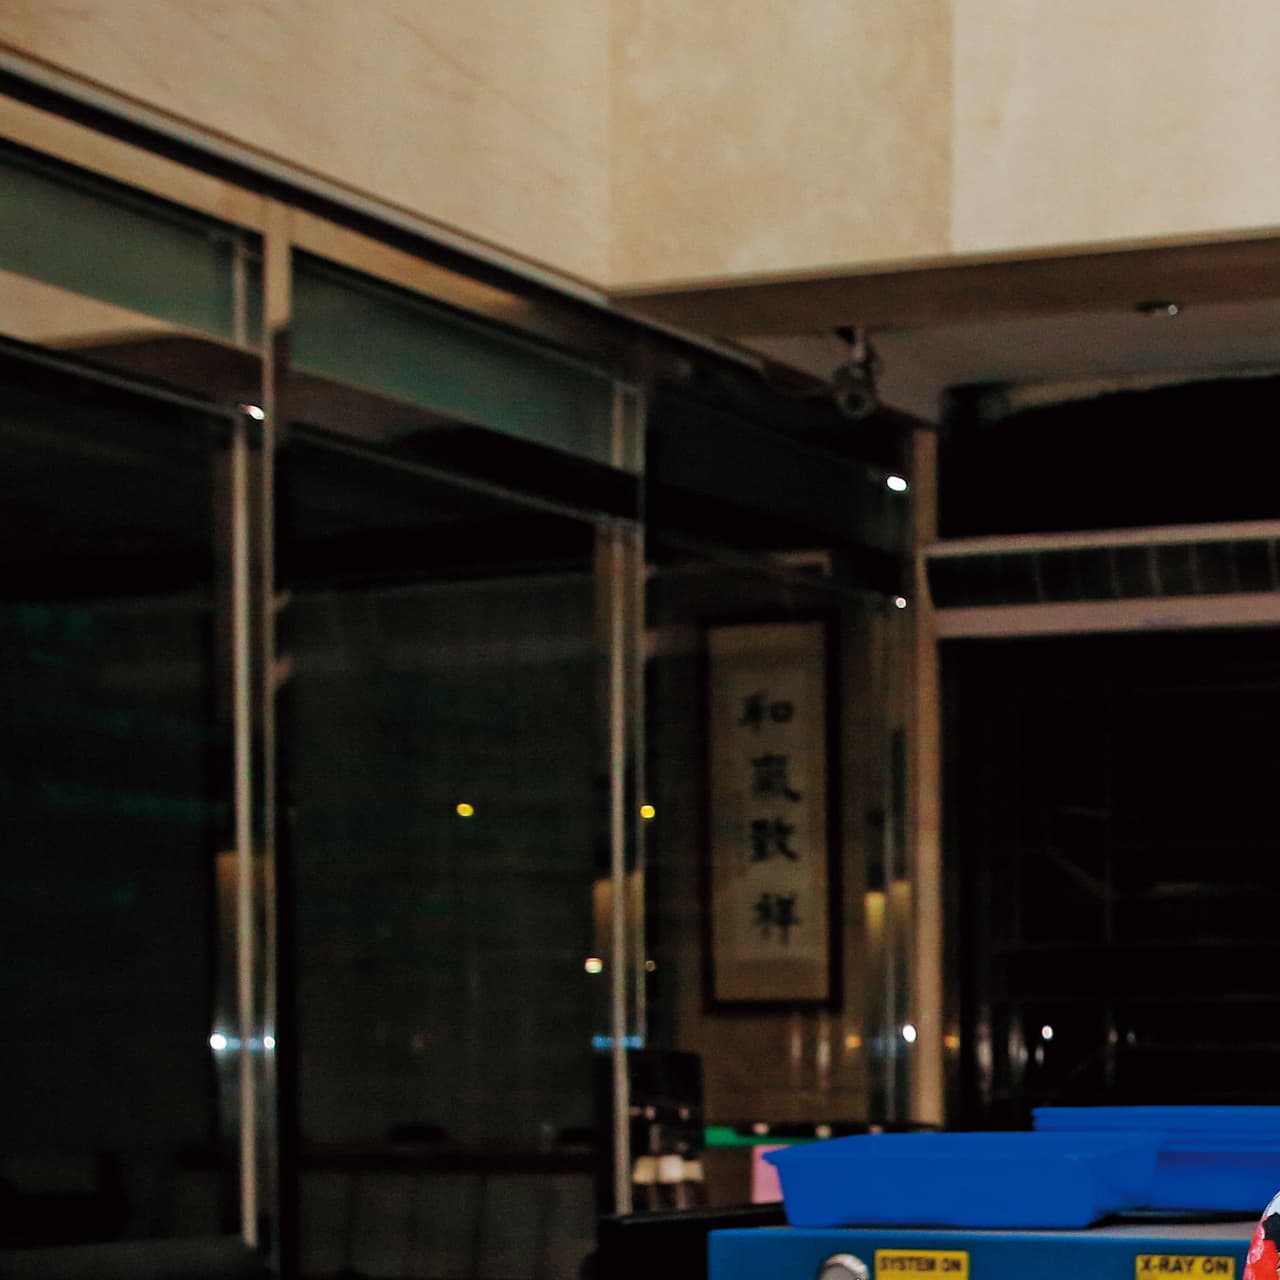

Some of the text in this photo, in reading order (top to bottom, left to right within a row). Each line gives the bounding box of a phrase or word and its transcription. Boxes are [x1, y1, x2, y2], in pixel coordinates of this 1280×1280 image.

[880, 1256, 962, 1273] SYSTEM ON
[1139, 1256, 1229, 1275] X-RAY ON
